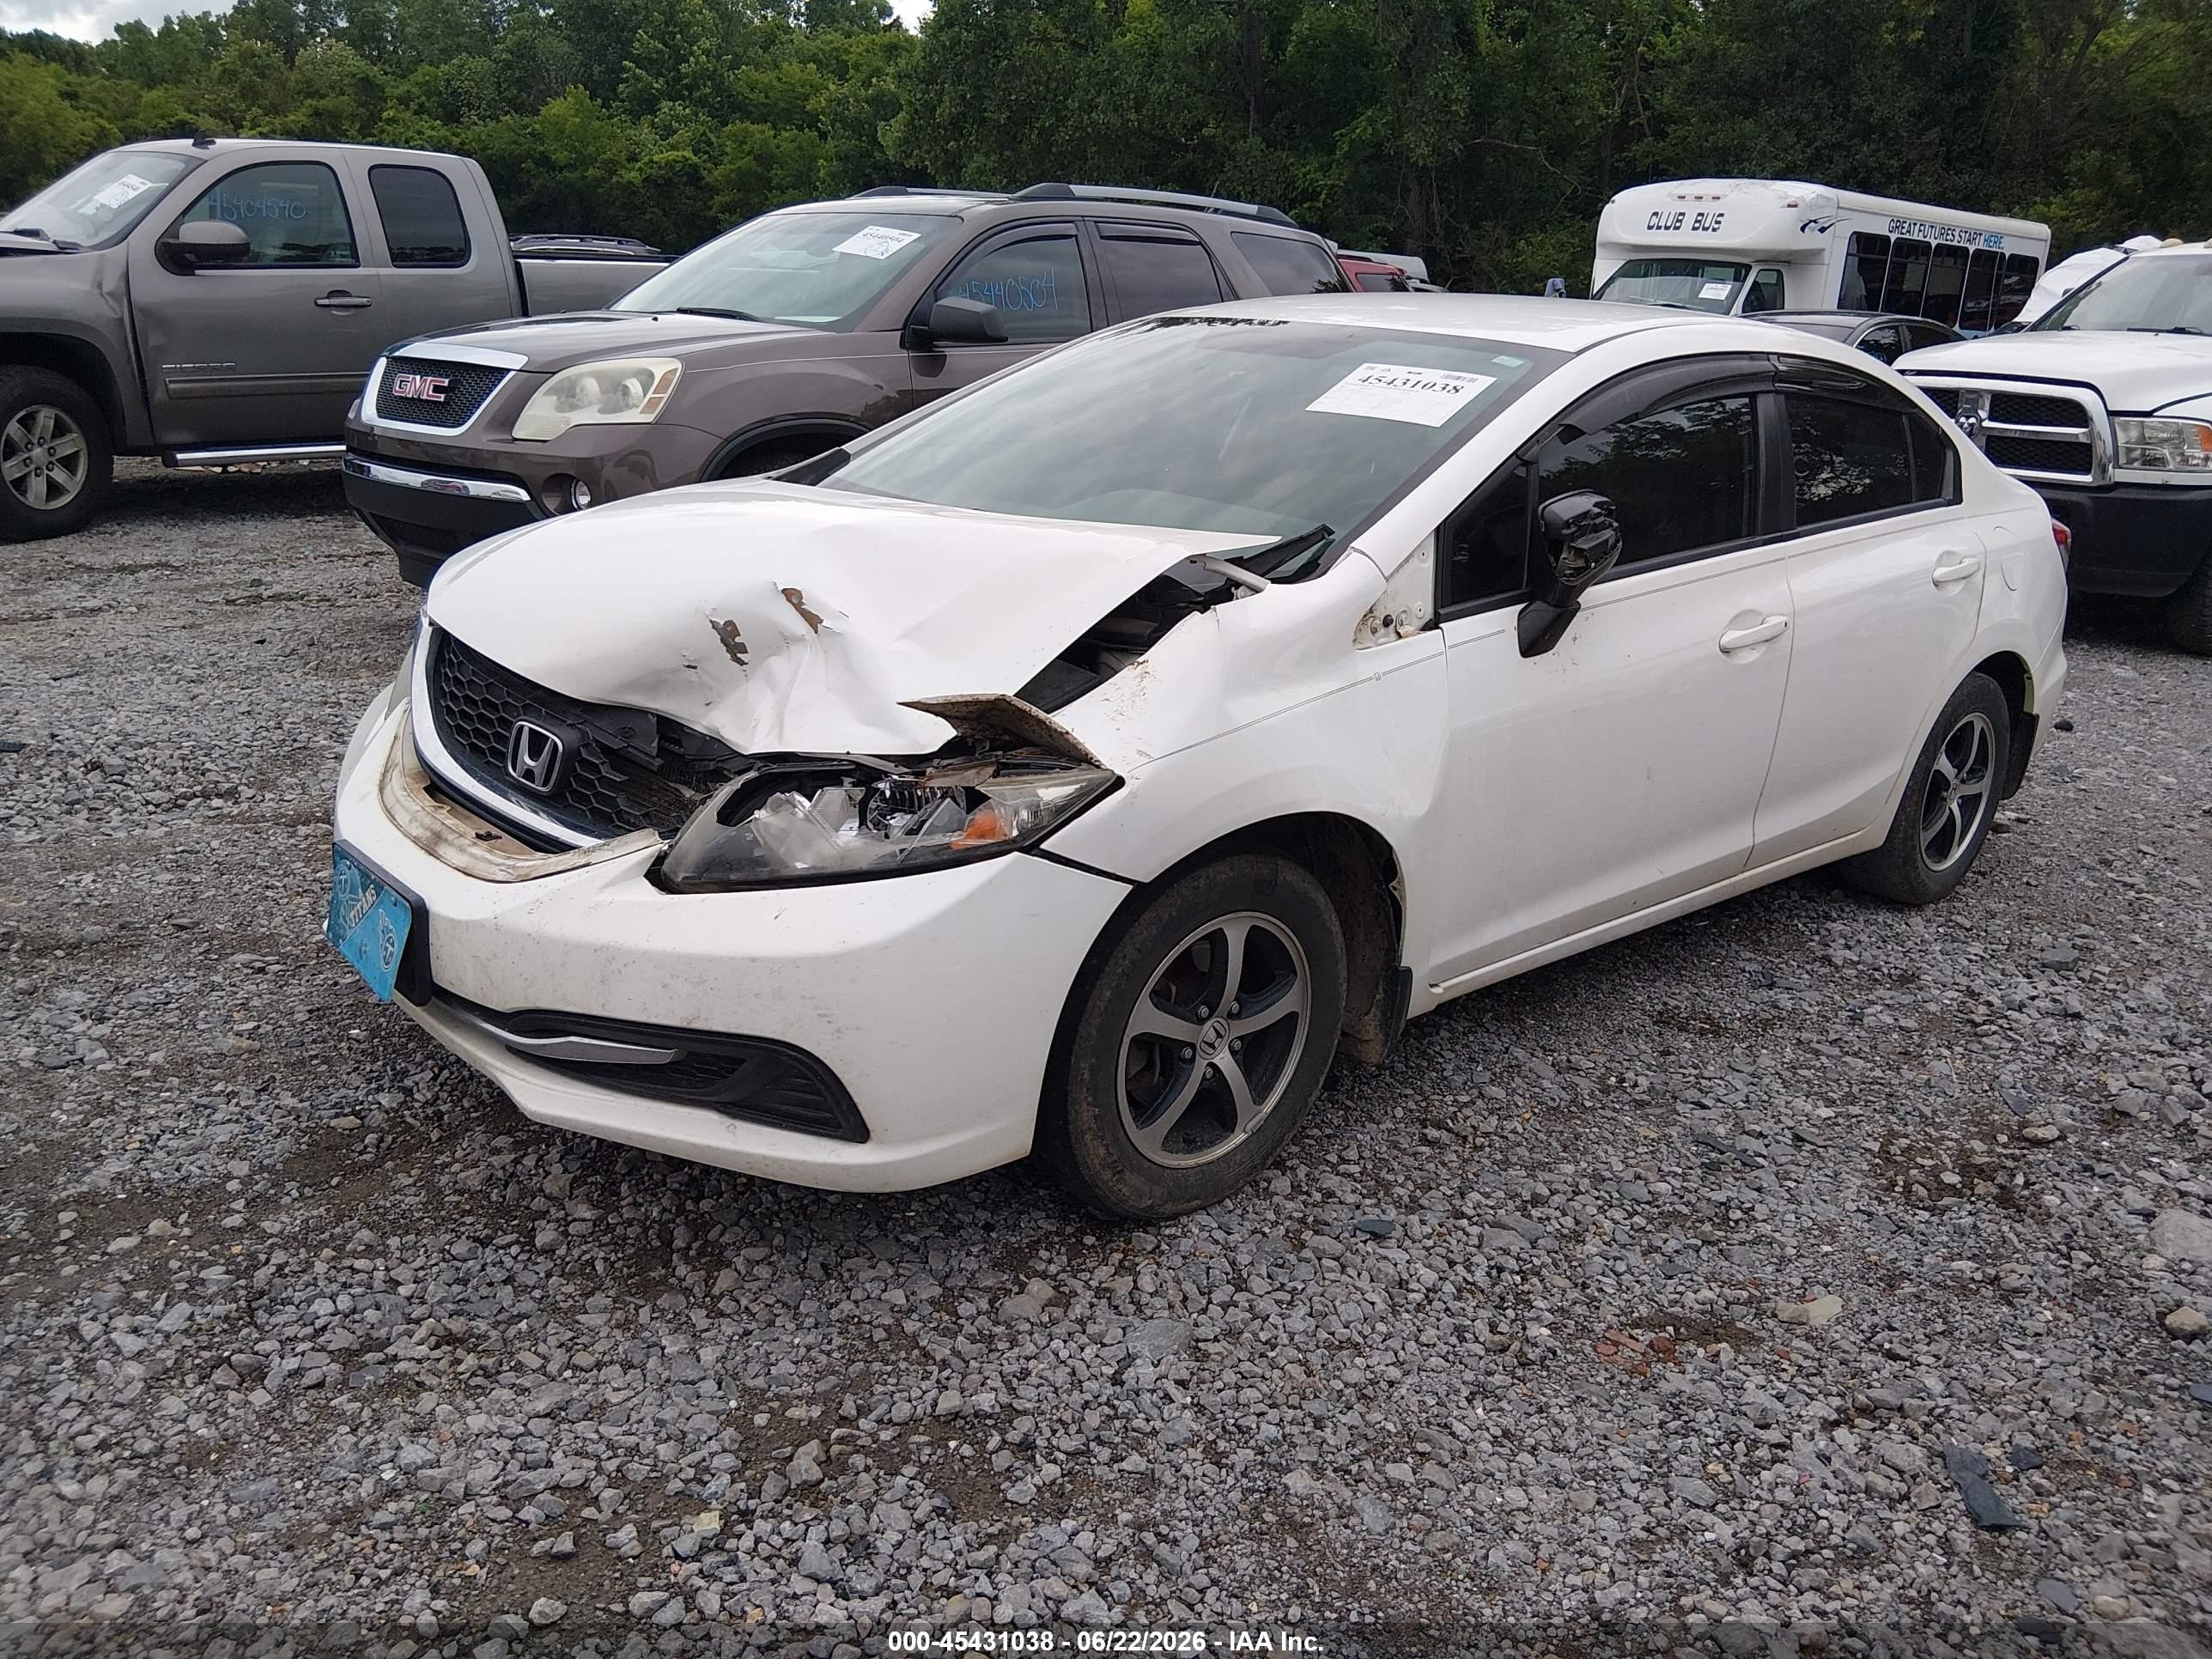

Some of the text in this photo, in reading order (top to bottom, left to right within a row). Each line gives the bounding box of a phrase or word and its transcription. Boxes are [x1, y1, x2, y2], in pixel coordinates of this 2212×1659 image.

[1646, 211, 1725, 233] CLUB BUS
[1888, 218, 1918, 238] GREAT
[1917, 223, 1956, 243] FUTURES
[1957, 229, 1984, 247] START
[392, 373, 451, 402] GMC
[1357, 374, 1466, 396] 45431038
[349, 883, 378, 929] TITANS
